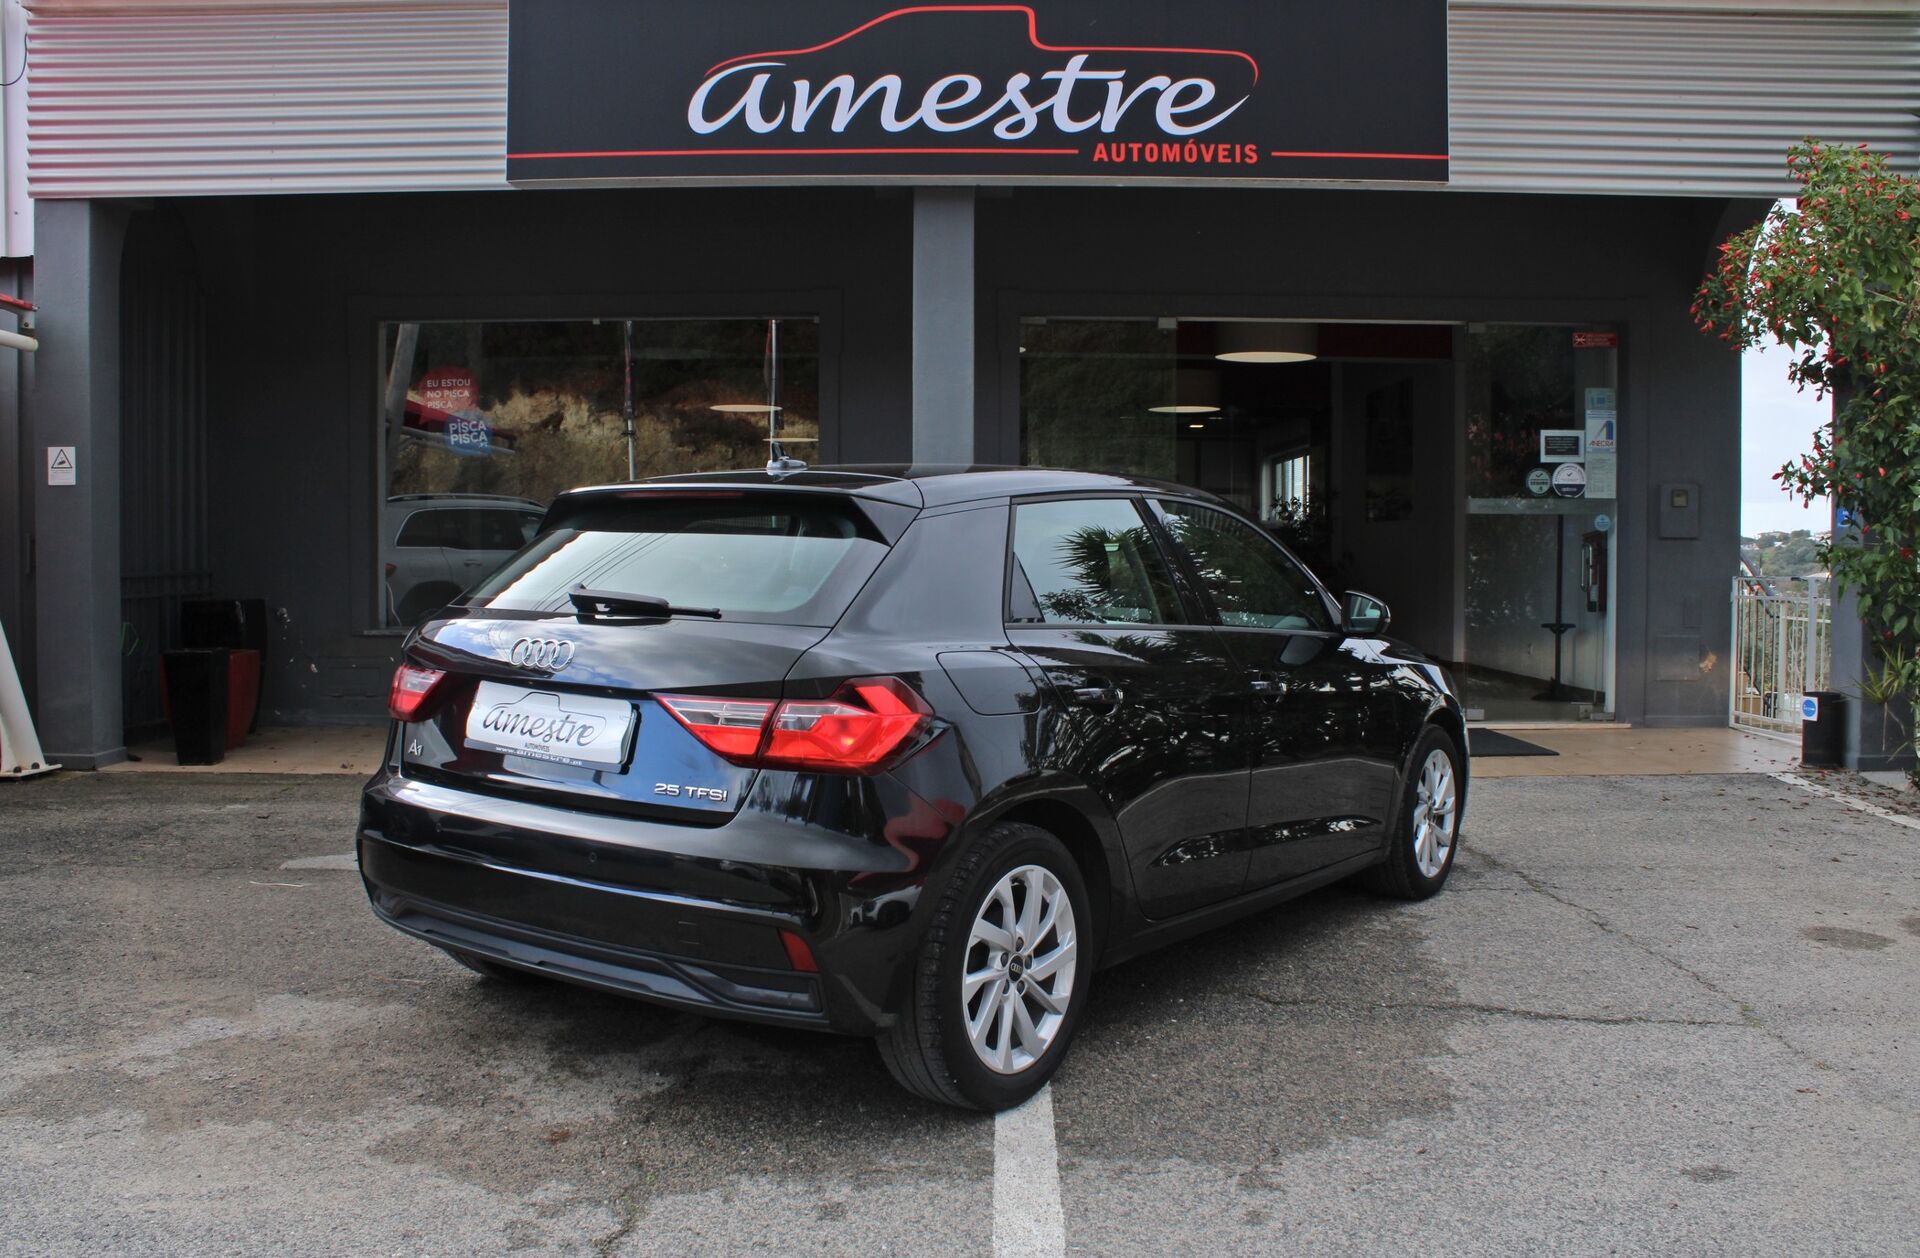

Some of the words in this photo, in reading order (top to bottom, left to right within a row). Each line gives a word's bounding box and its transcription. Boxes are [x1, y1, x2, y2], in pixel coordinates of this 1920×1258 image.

[687, 54, 1249, 139] amestre
[1092, 138, 1259, 164] AUTOMÓVEIS
[442, 379, 470, 387] ESTOU
[482, 705, 597, 747] amestre
[408, 739, 424, 757] A1
[495, 746, 583, 766] www.amestre.pt
[653, 782, 680, 798] 25
[684, 785, 729, 803] TFSI
